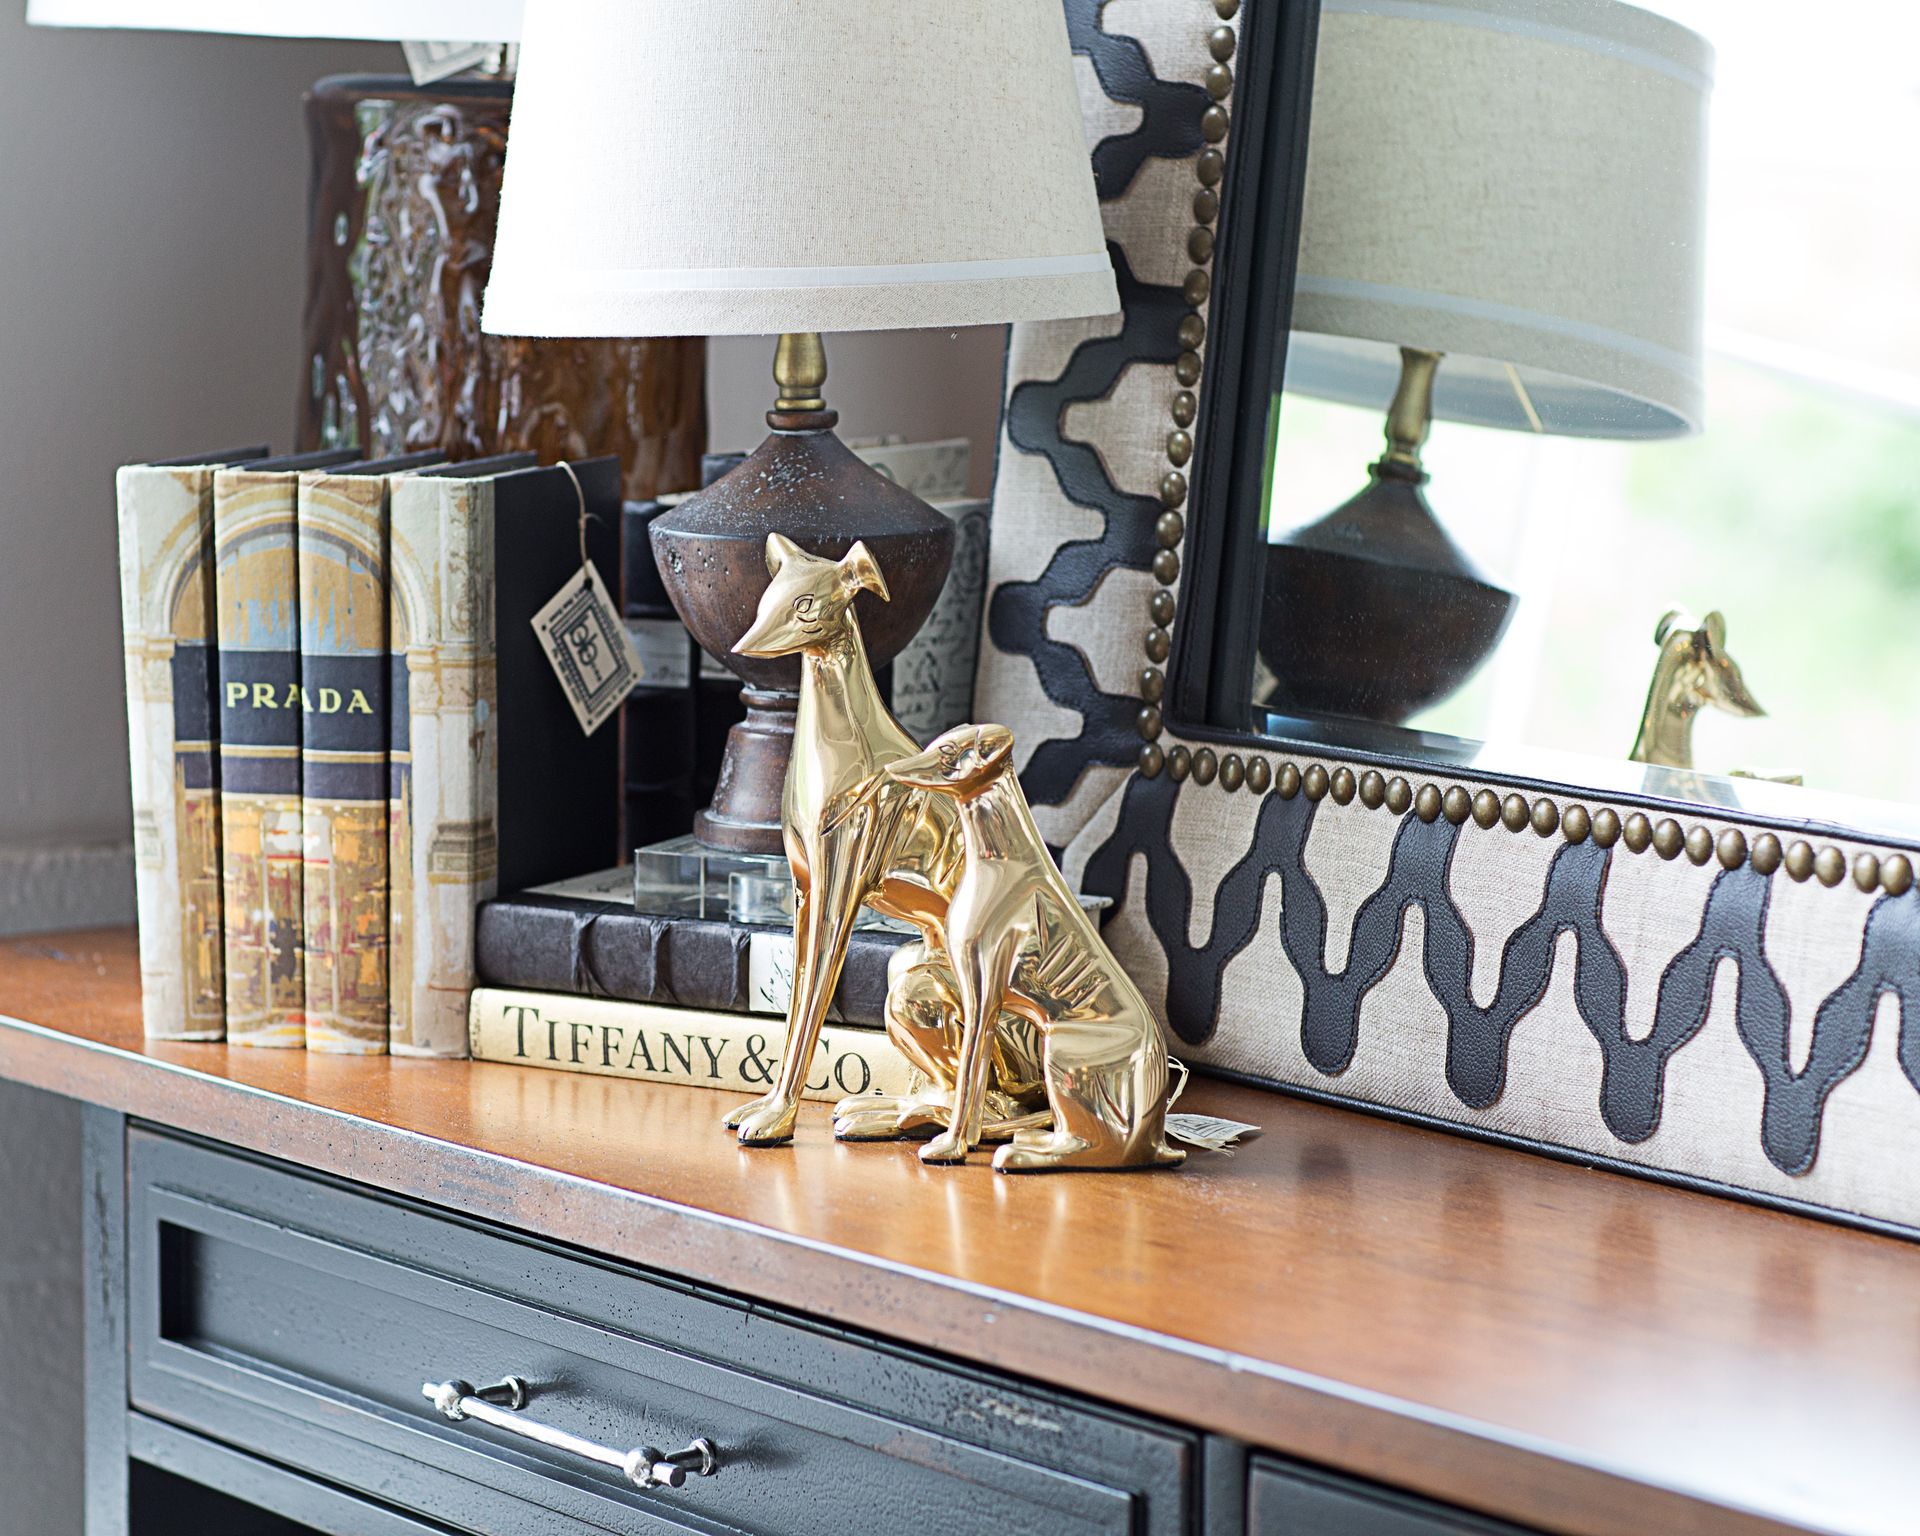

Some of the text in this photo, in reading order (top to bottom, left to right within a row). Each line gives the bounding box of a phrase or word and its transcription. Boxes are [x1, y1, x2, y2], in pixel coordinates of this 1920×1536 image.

[226, 682, 373, 714] PRADA
[503, 1005, 729, 1079] TIFFANY
[738, 1034, 779, 1085] &
